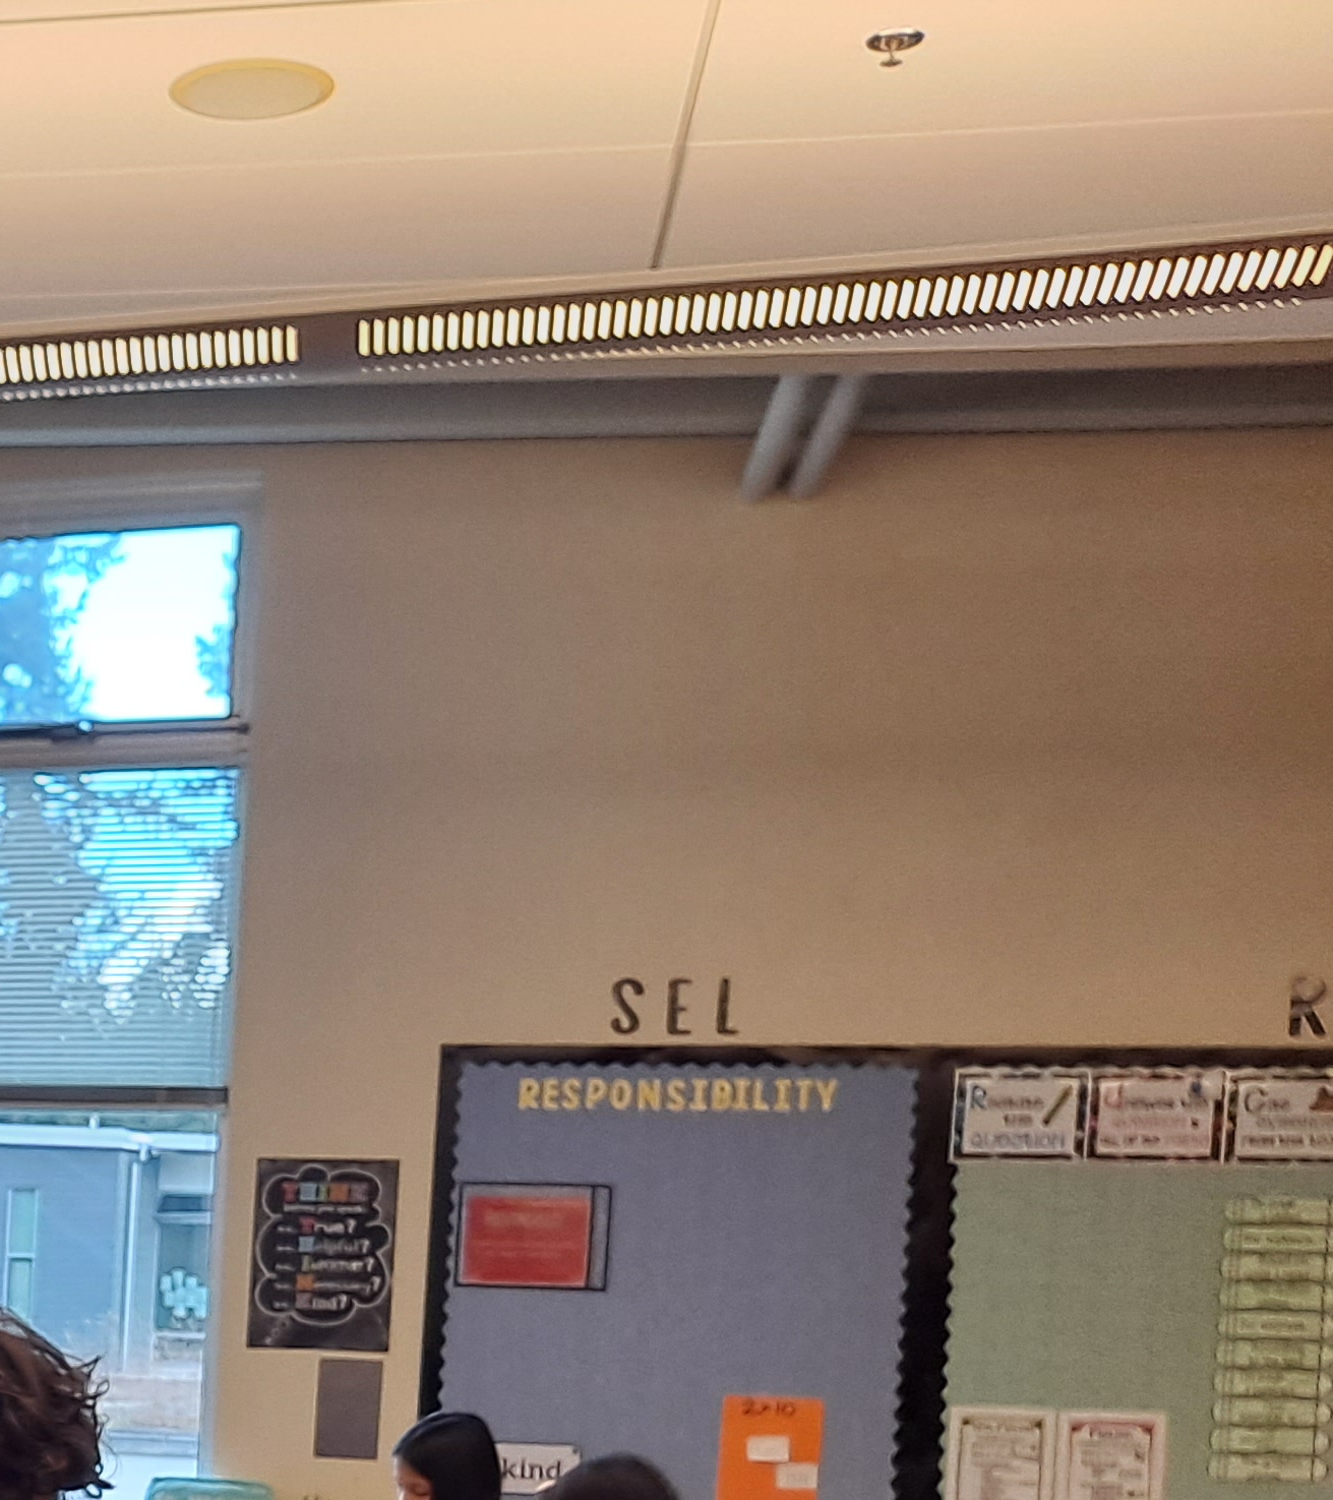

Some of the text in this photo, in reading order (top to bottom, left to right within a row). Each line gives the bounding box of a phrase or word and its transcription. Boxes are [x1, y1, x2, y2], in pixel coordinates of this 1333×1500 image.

[610, 977, 739, 1035] SEL
[517, 1077, 838, 1113] RESPONSIBILITY
[501, 1458, 562, 1480] kind
